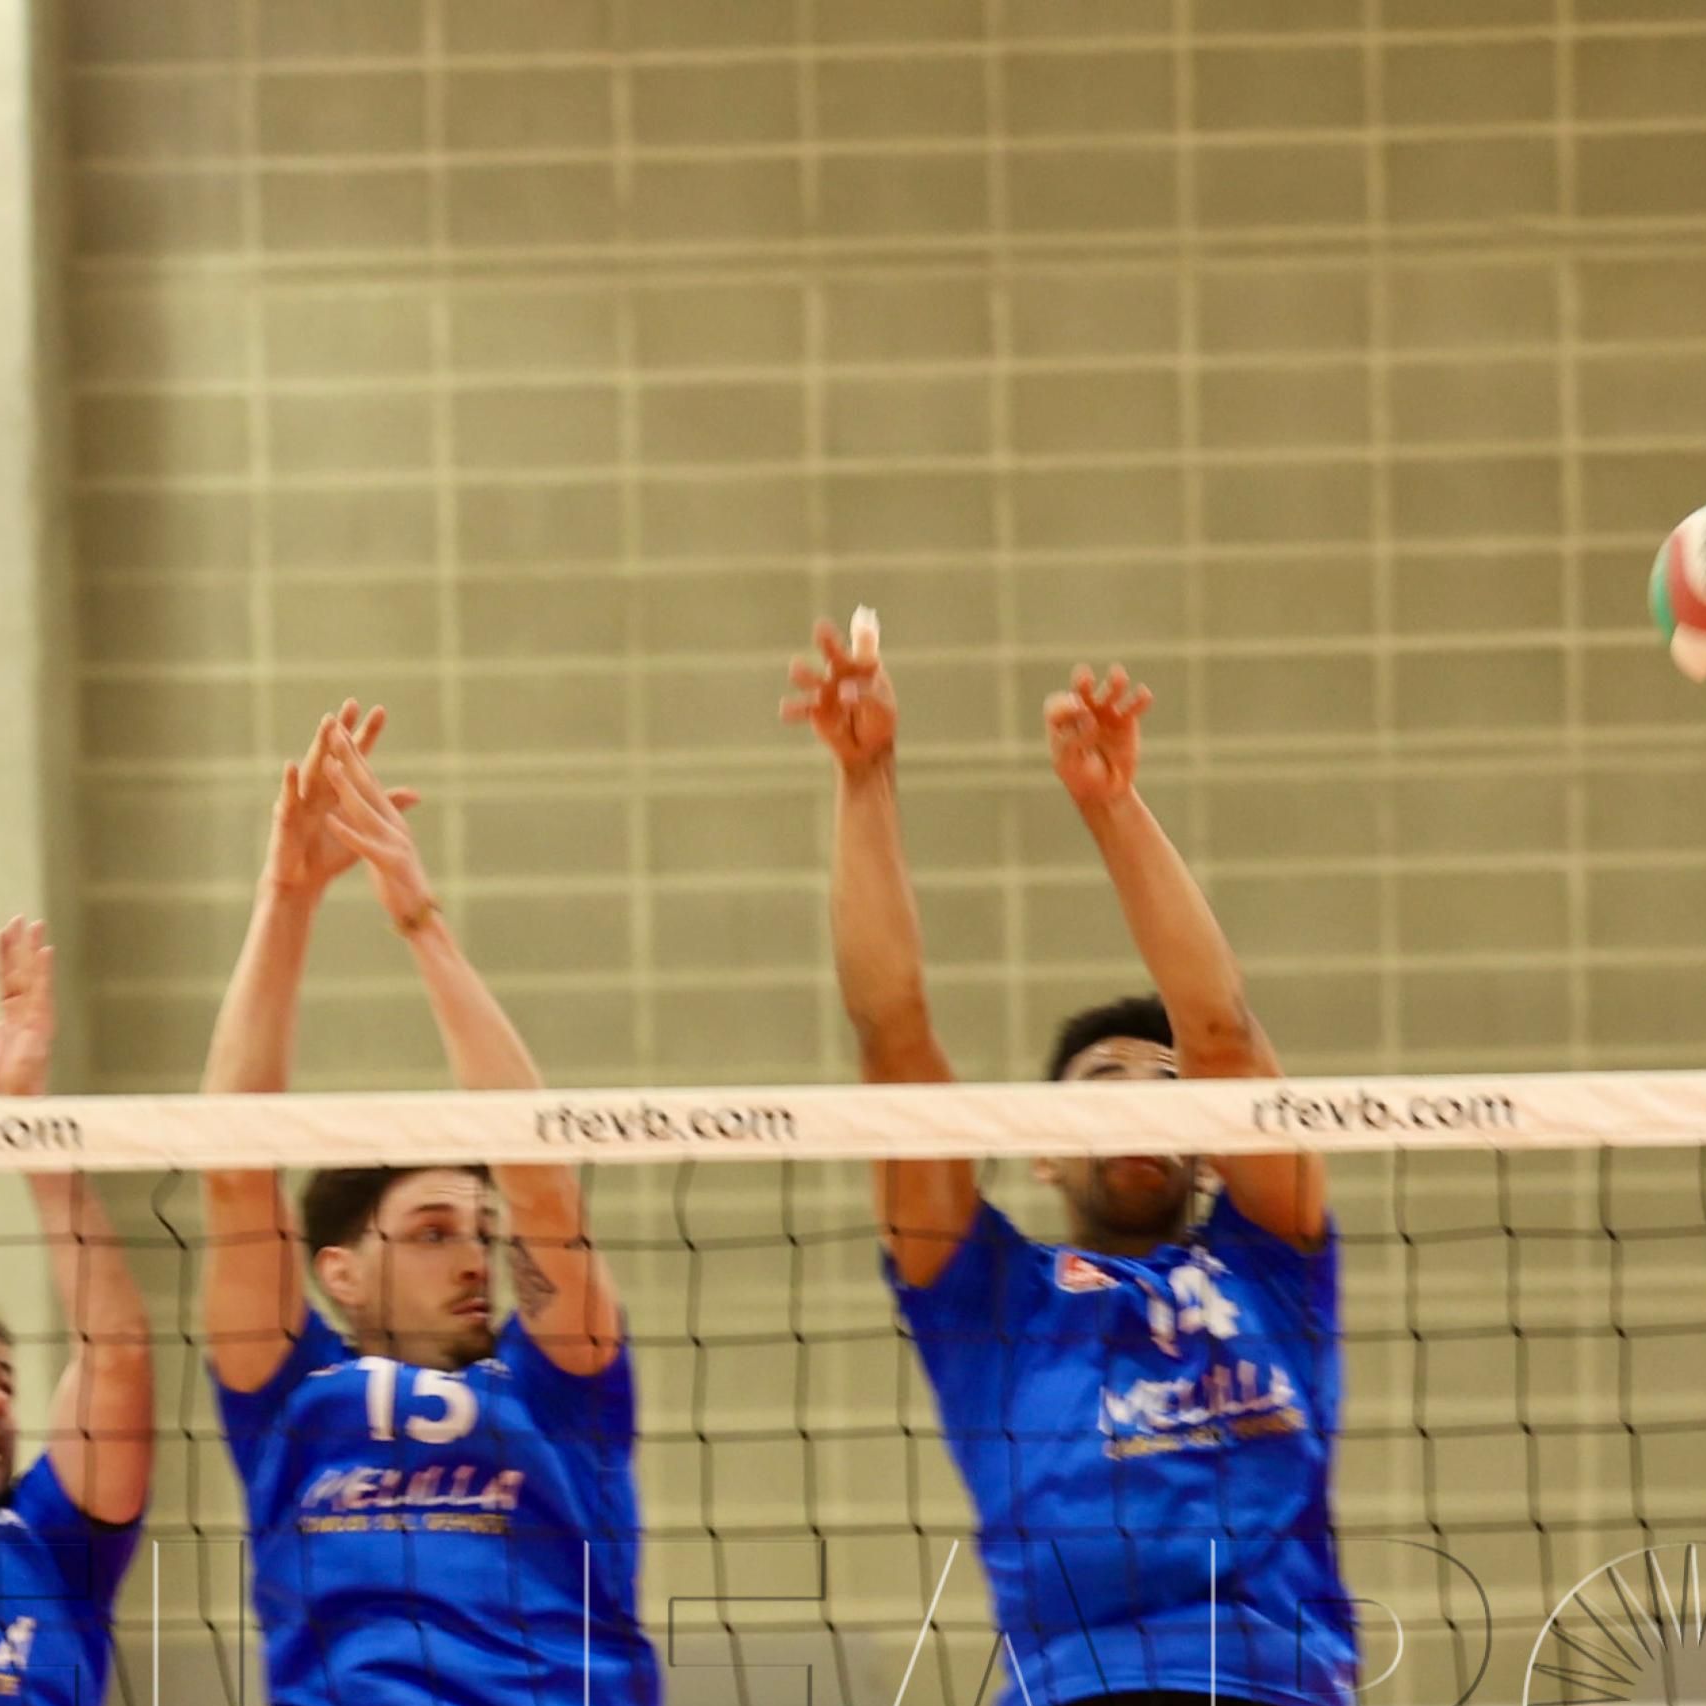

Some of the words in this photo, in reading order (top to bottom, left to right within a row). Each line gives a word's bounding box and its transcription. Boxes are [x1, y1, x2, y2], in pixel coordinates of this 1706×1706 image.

[535, 1099, 797, 1144] rfevb.com
[1252, 1089, 1515, 1132] rfevb.com
[354, 1355, 481, 1444] 15
